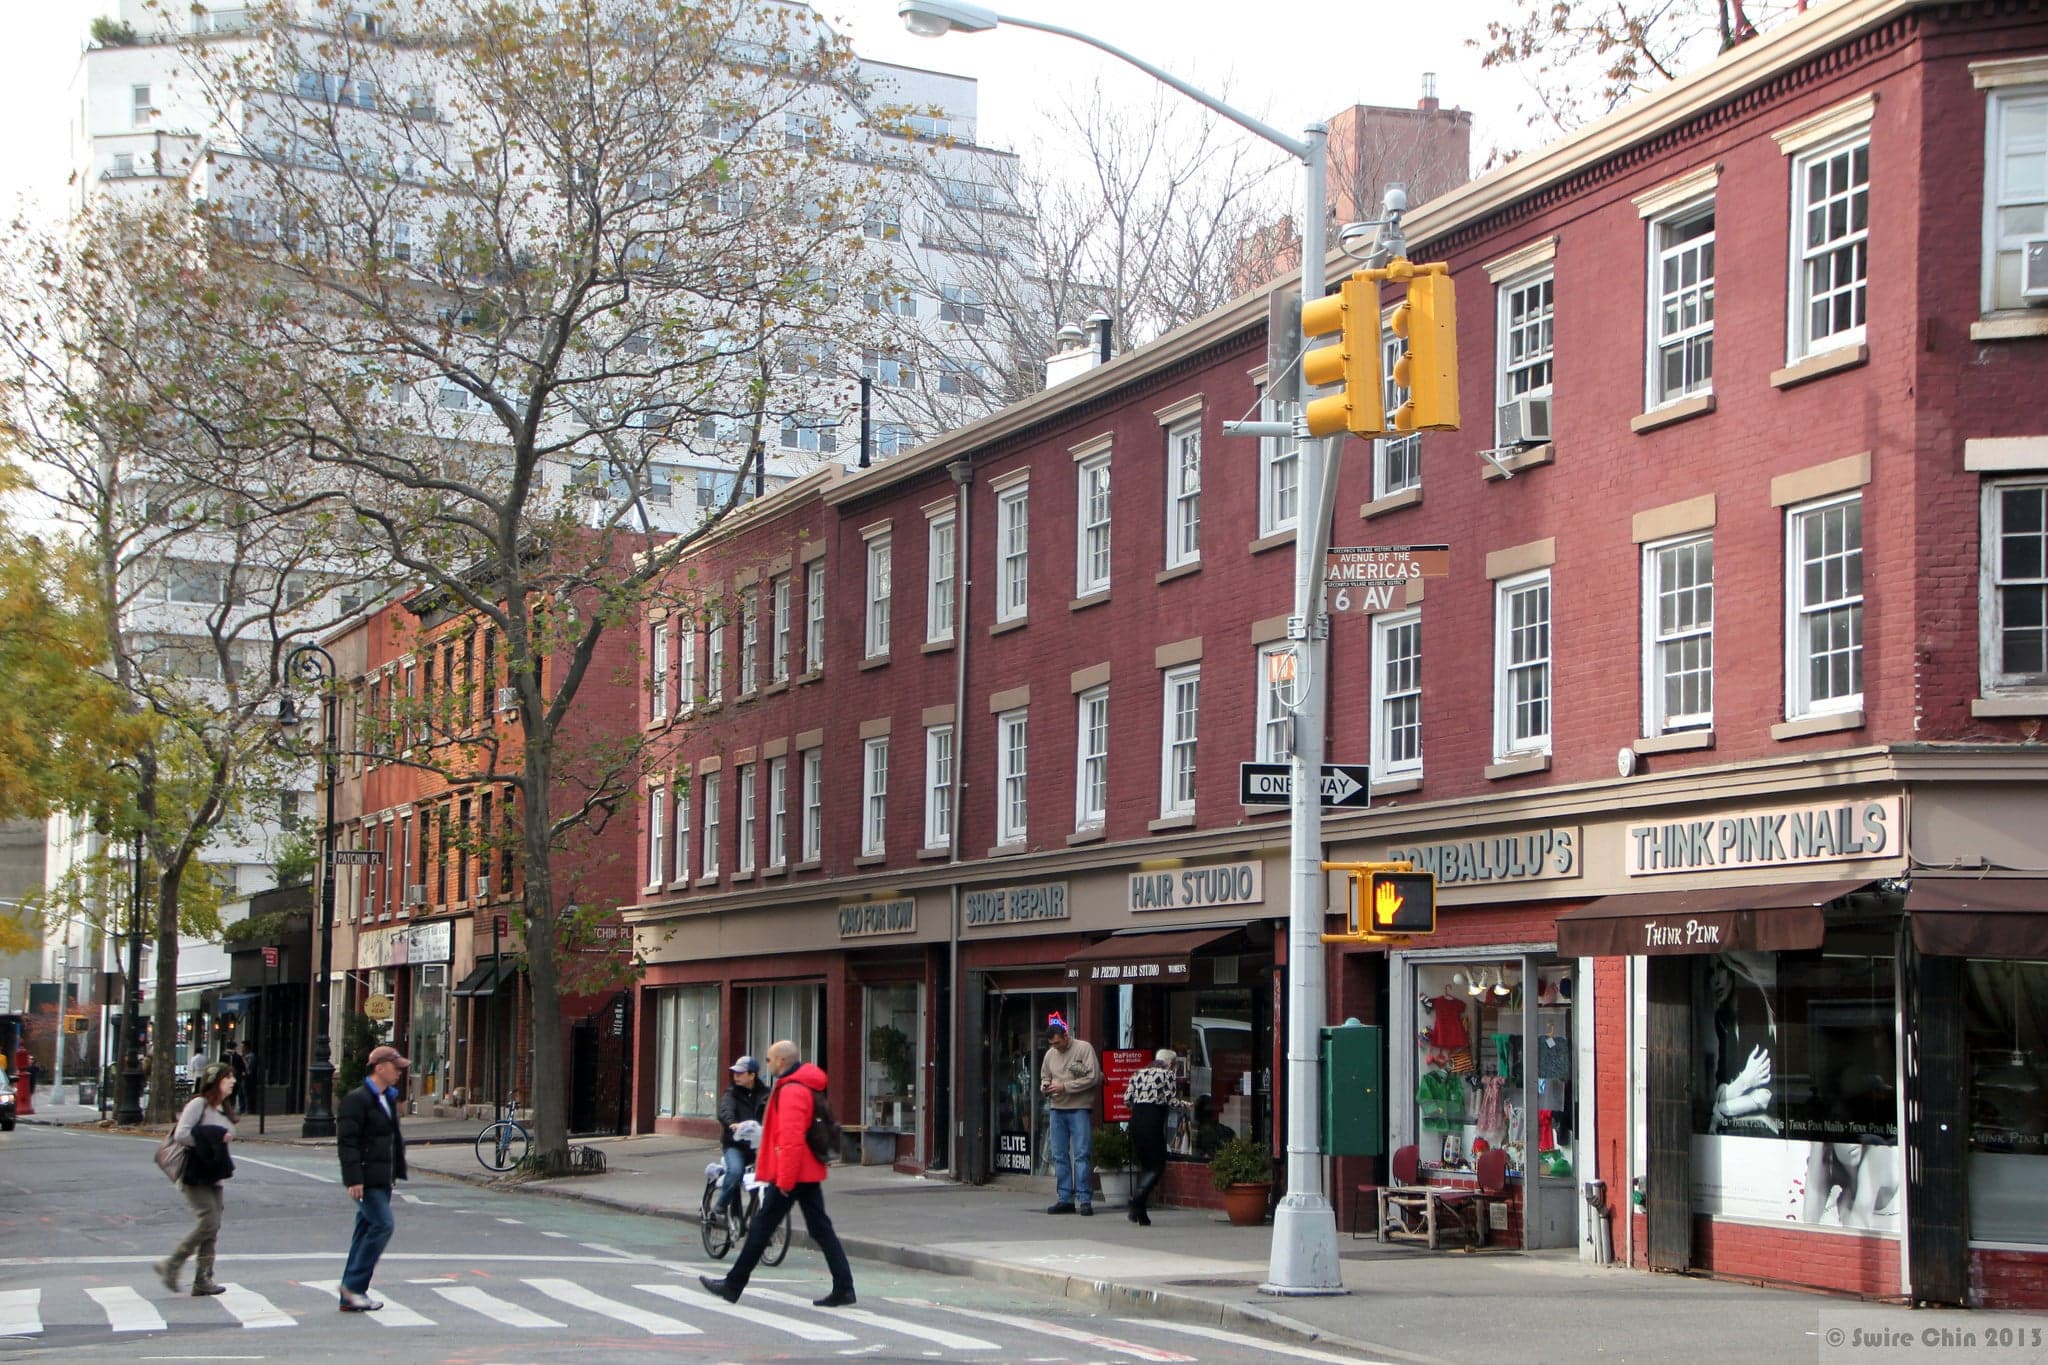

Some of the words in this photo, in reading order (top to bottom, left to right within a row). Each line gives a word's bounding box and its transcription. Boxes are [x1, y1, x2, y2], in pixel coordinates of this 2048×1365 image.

[1340, 553, 1374, 562] AVENUE
[1378, 553, 1389, 561] OF
[1394, 552, 1410, 561] THE
[1329, 562, 1420, 580] AMERICAS
[1335, 588, 1350, 611] 6
[1363, 586, 1394, 610] AV
[1632, 821, 1715, 870] THINK
[1719, 814, 1787, 864] PINK
[1791, 803, 1887, 859] NAILS
[338, 853, 368, 864] PATCHIN
[371, 854, 381, 864] PL
[1132, 873, 1174, 909] HAIR
[1181, 865, 1253, 905] STUDIO
[966, 891, 1005, 923] SHOE
[1008, 886, 1064, 920] REPAIR
[863, 904, 886, 933] FOR
[887, 901, 914, 931] NOW
[621, 928, 633, 938] PL
[1100, 966, 1120, 978] PIETRO
[1122, 965, 1138, 978] HAIR
[1139, 964, 1160, 977] STUDIO
[1001, 1135, 1026, 1152] ELITE
[996, 1153, 1011, 1169] SHOE
[1012, 1154, 1031, 1170] REPAIR
